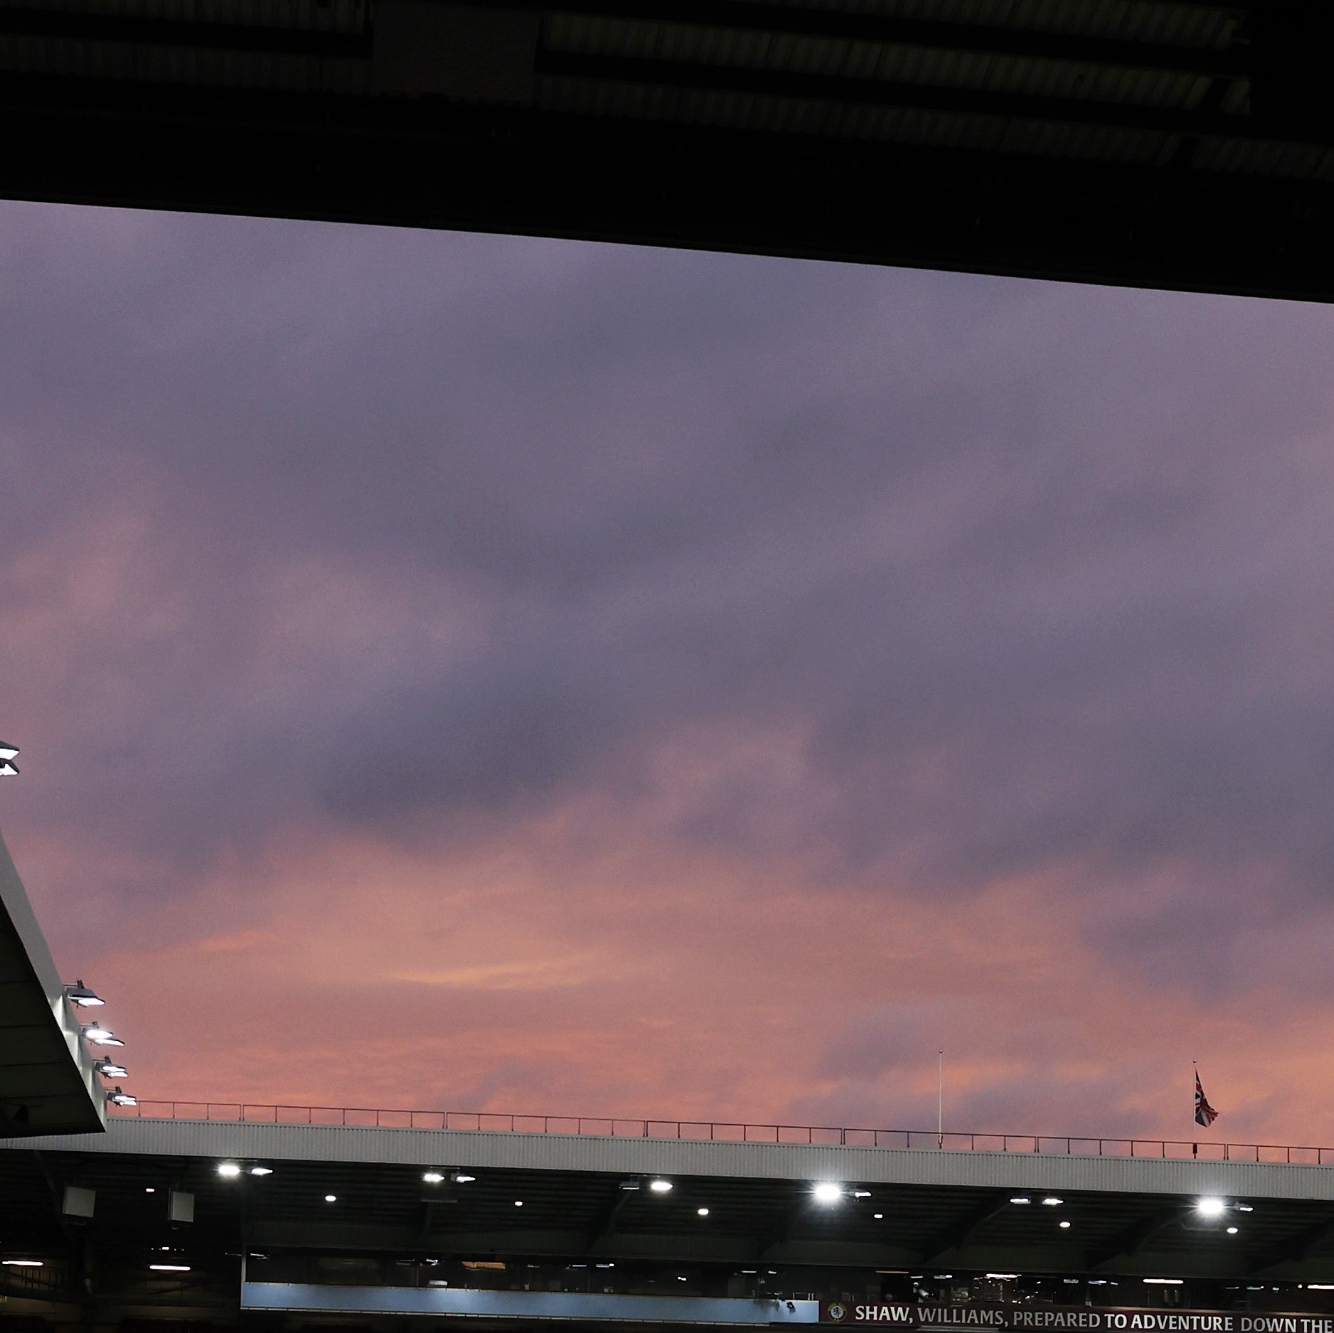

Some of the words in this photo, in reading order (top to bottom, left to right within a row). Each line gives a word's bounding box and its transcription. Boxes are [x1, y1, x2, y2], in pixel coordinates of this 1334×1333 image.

[855, 1305, 913, 1324] SHAW,
[917, 1307, 1009, 1327] WILLIAMS,
[1013, 1311, 1101, 1328] PREPARED
[1104, 1313, 1127, 1329] TO
[1130, 1313, 1234, 1332] ADVENTURE
[1240, 1316, 1297, 1333] DOWN
[1301, 1318, 1333, 1333] THE
